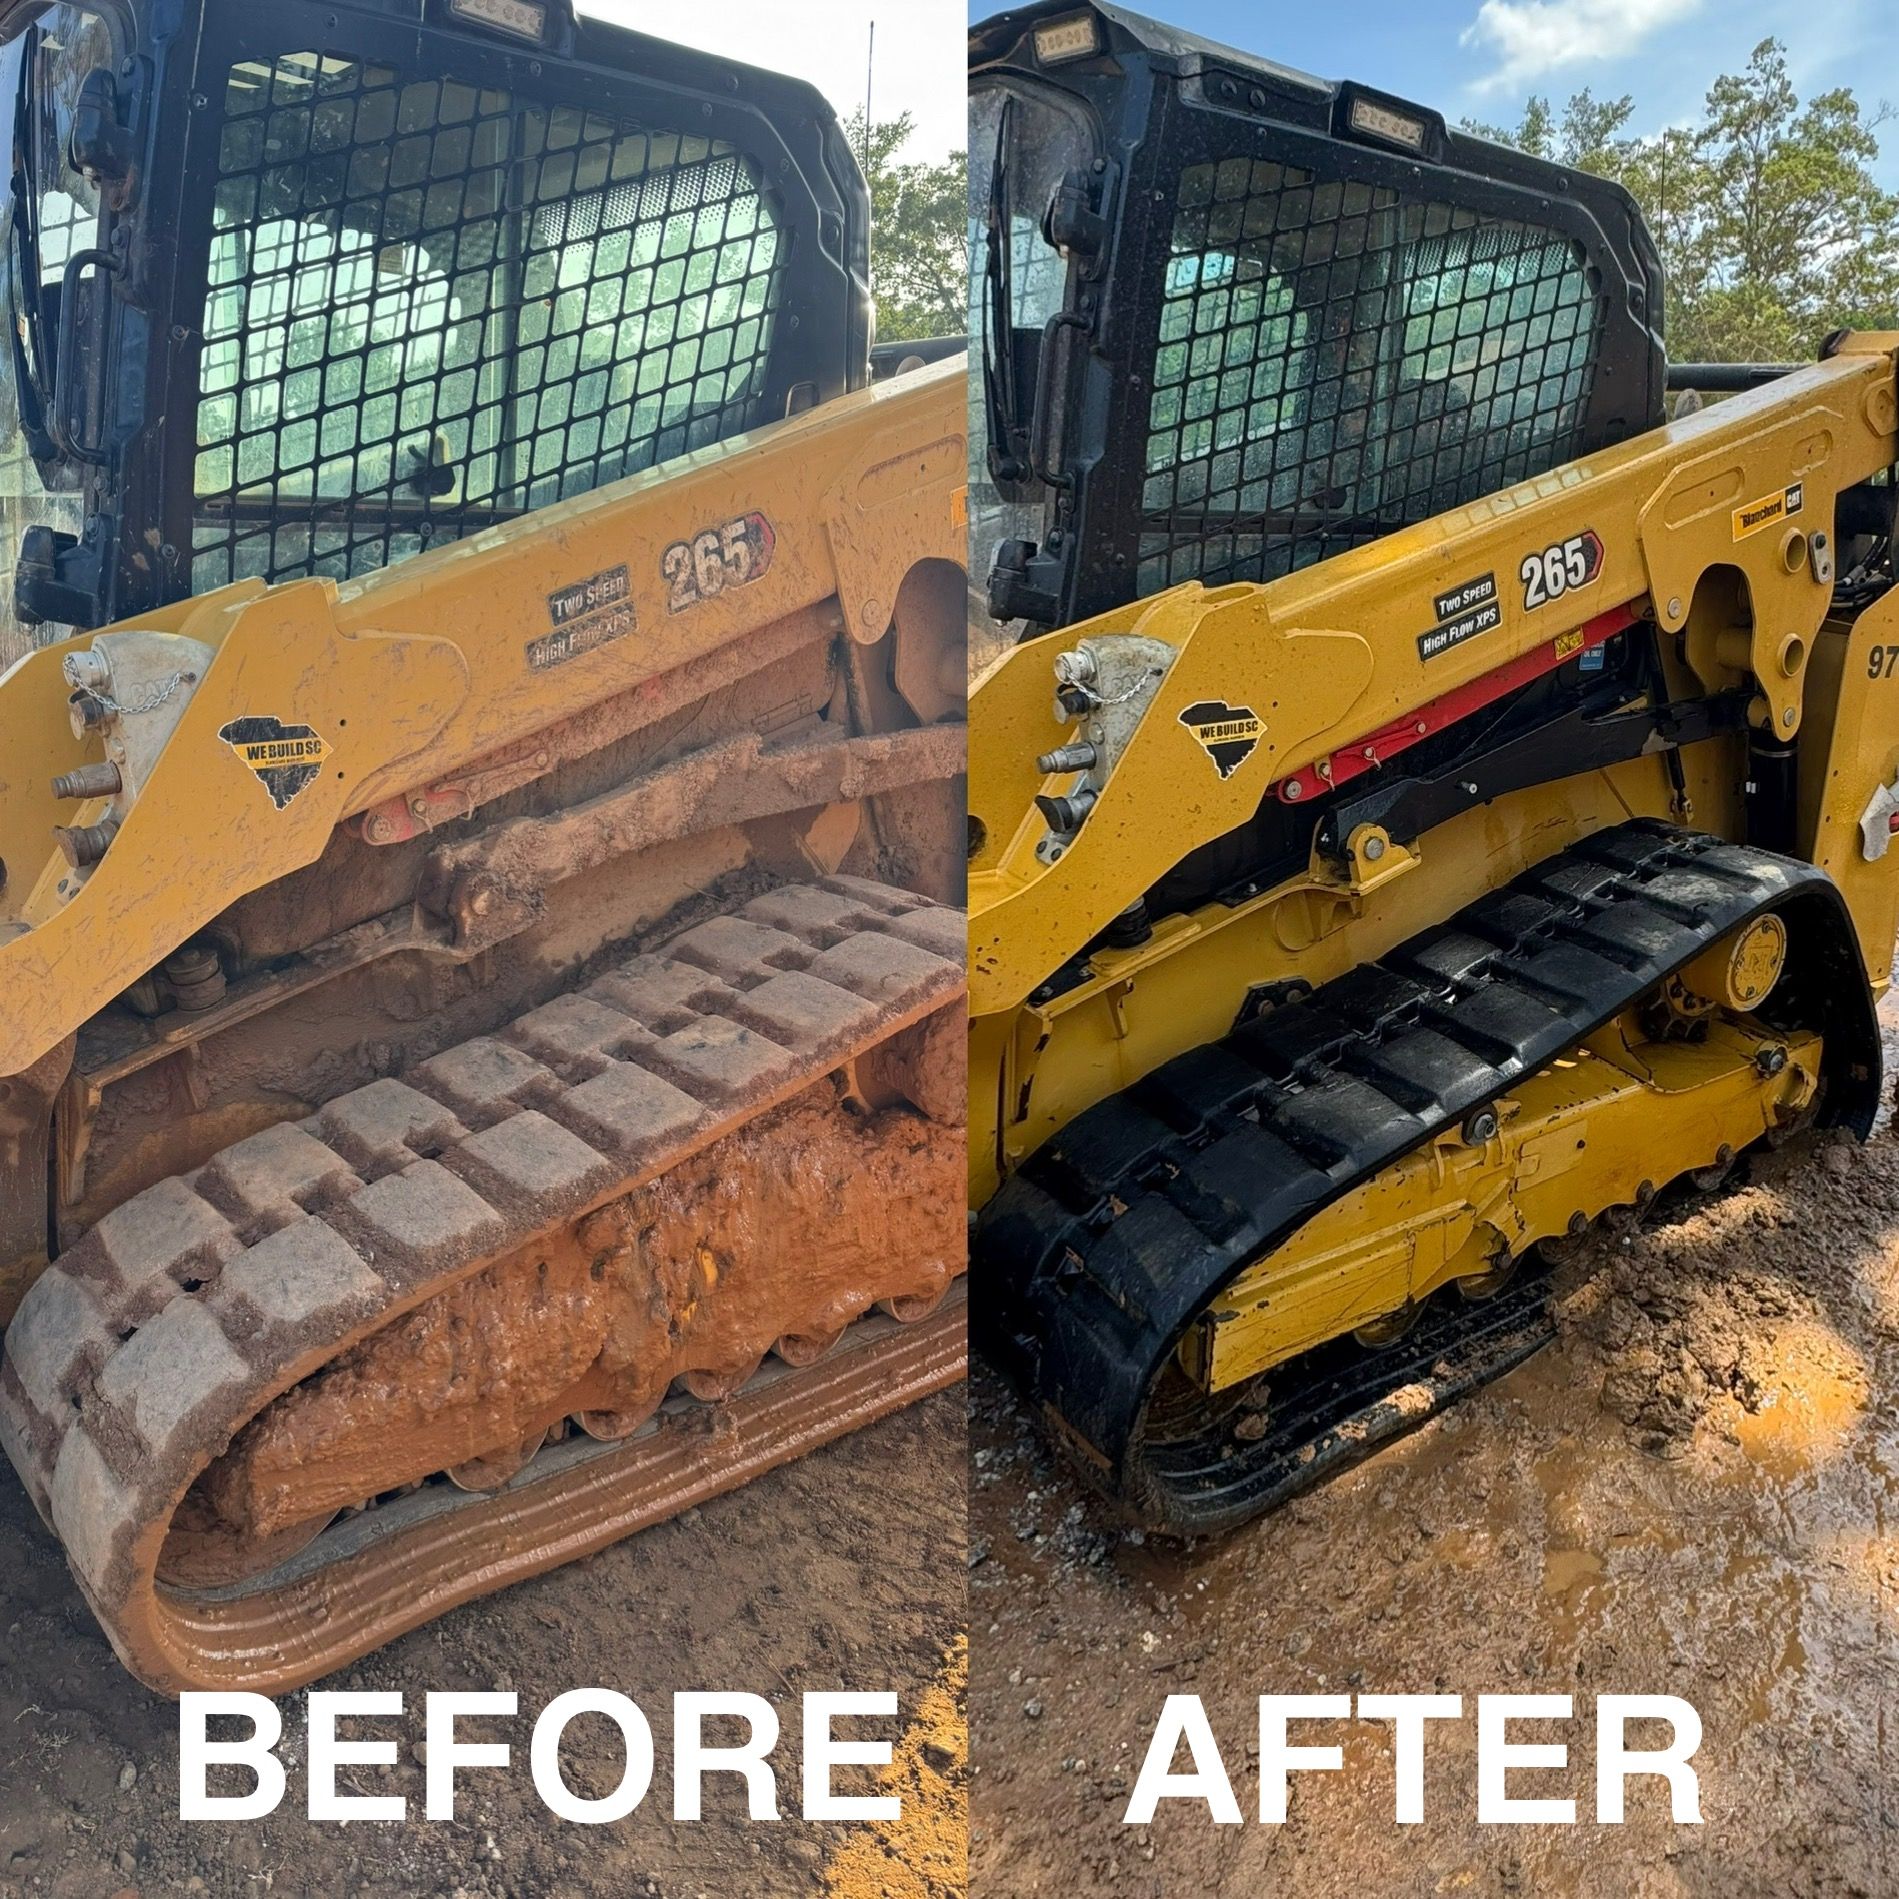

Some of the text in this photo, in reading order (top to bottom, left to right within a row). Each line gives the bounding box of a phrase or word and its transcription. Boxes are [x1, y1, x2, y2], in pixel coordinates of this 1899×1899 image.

[1740, 499, 1782, 528] Blanchard
[1786, 490, 1801, 509] CAT
[665, 519, 751, 609] 265
[1521, 537, 1586, 608] 265
[554, 593, 583, 617] TWO
[1439, 581, 1492, 615] TWO SPEED
[1423, 607, 1496, 655] HIGH FLOW XPS
[535, 639, 565, 666] HIGH
[1200, 726, 1216, 739] WE
[1216, 722, 1245, 737] BUILD
[1245, 720, 1259, 732] SC
[246, 745, 267, 761] WE
[268, 742, 305, 759] BUILD
[305, 740, 322, 755] SC
